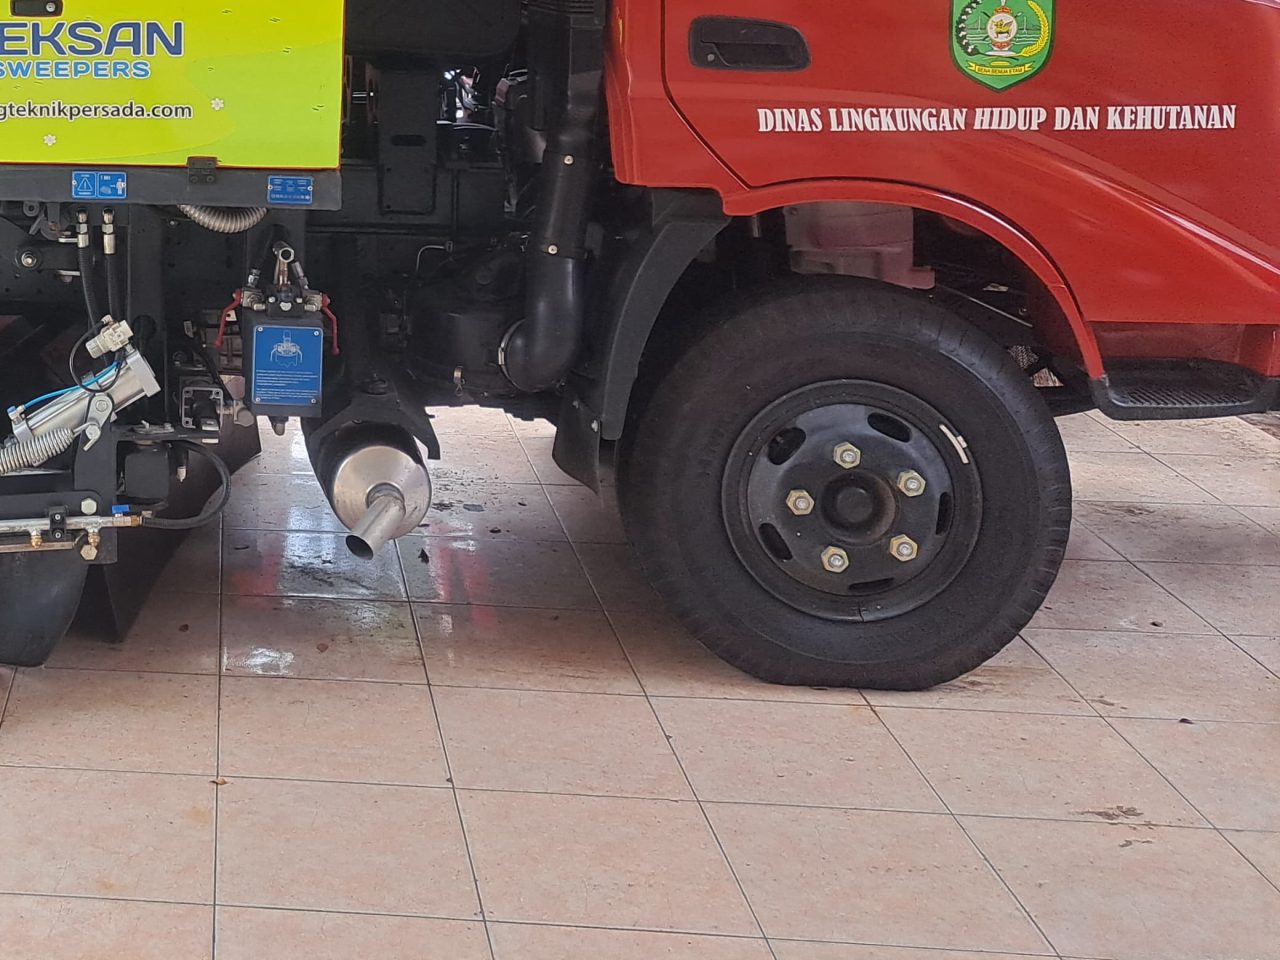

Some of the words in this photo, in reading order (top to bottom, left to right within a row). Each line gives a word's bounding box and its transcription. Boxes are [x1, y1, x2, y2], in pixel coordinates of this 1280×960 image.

[757, 107, 822, 132] DINAS
[829, 107, 967, 132] LINGKUNGAN
[973, 107, 1047, 131] HIDUP
[1054, 106, 1101, 131] DAN
[1106, 105, 1237, 130] KEHUTANAN
